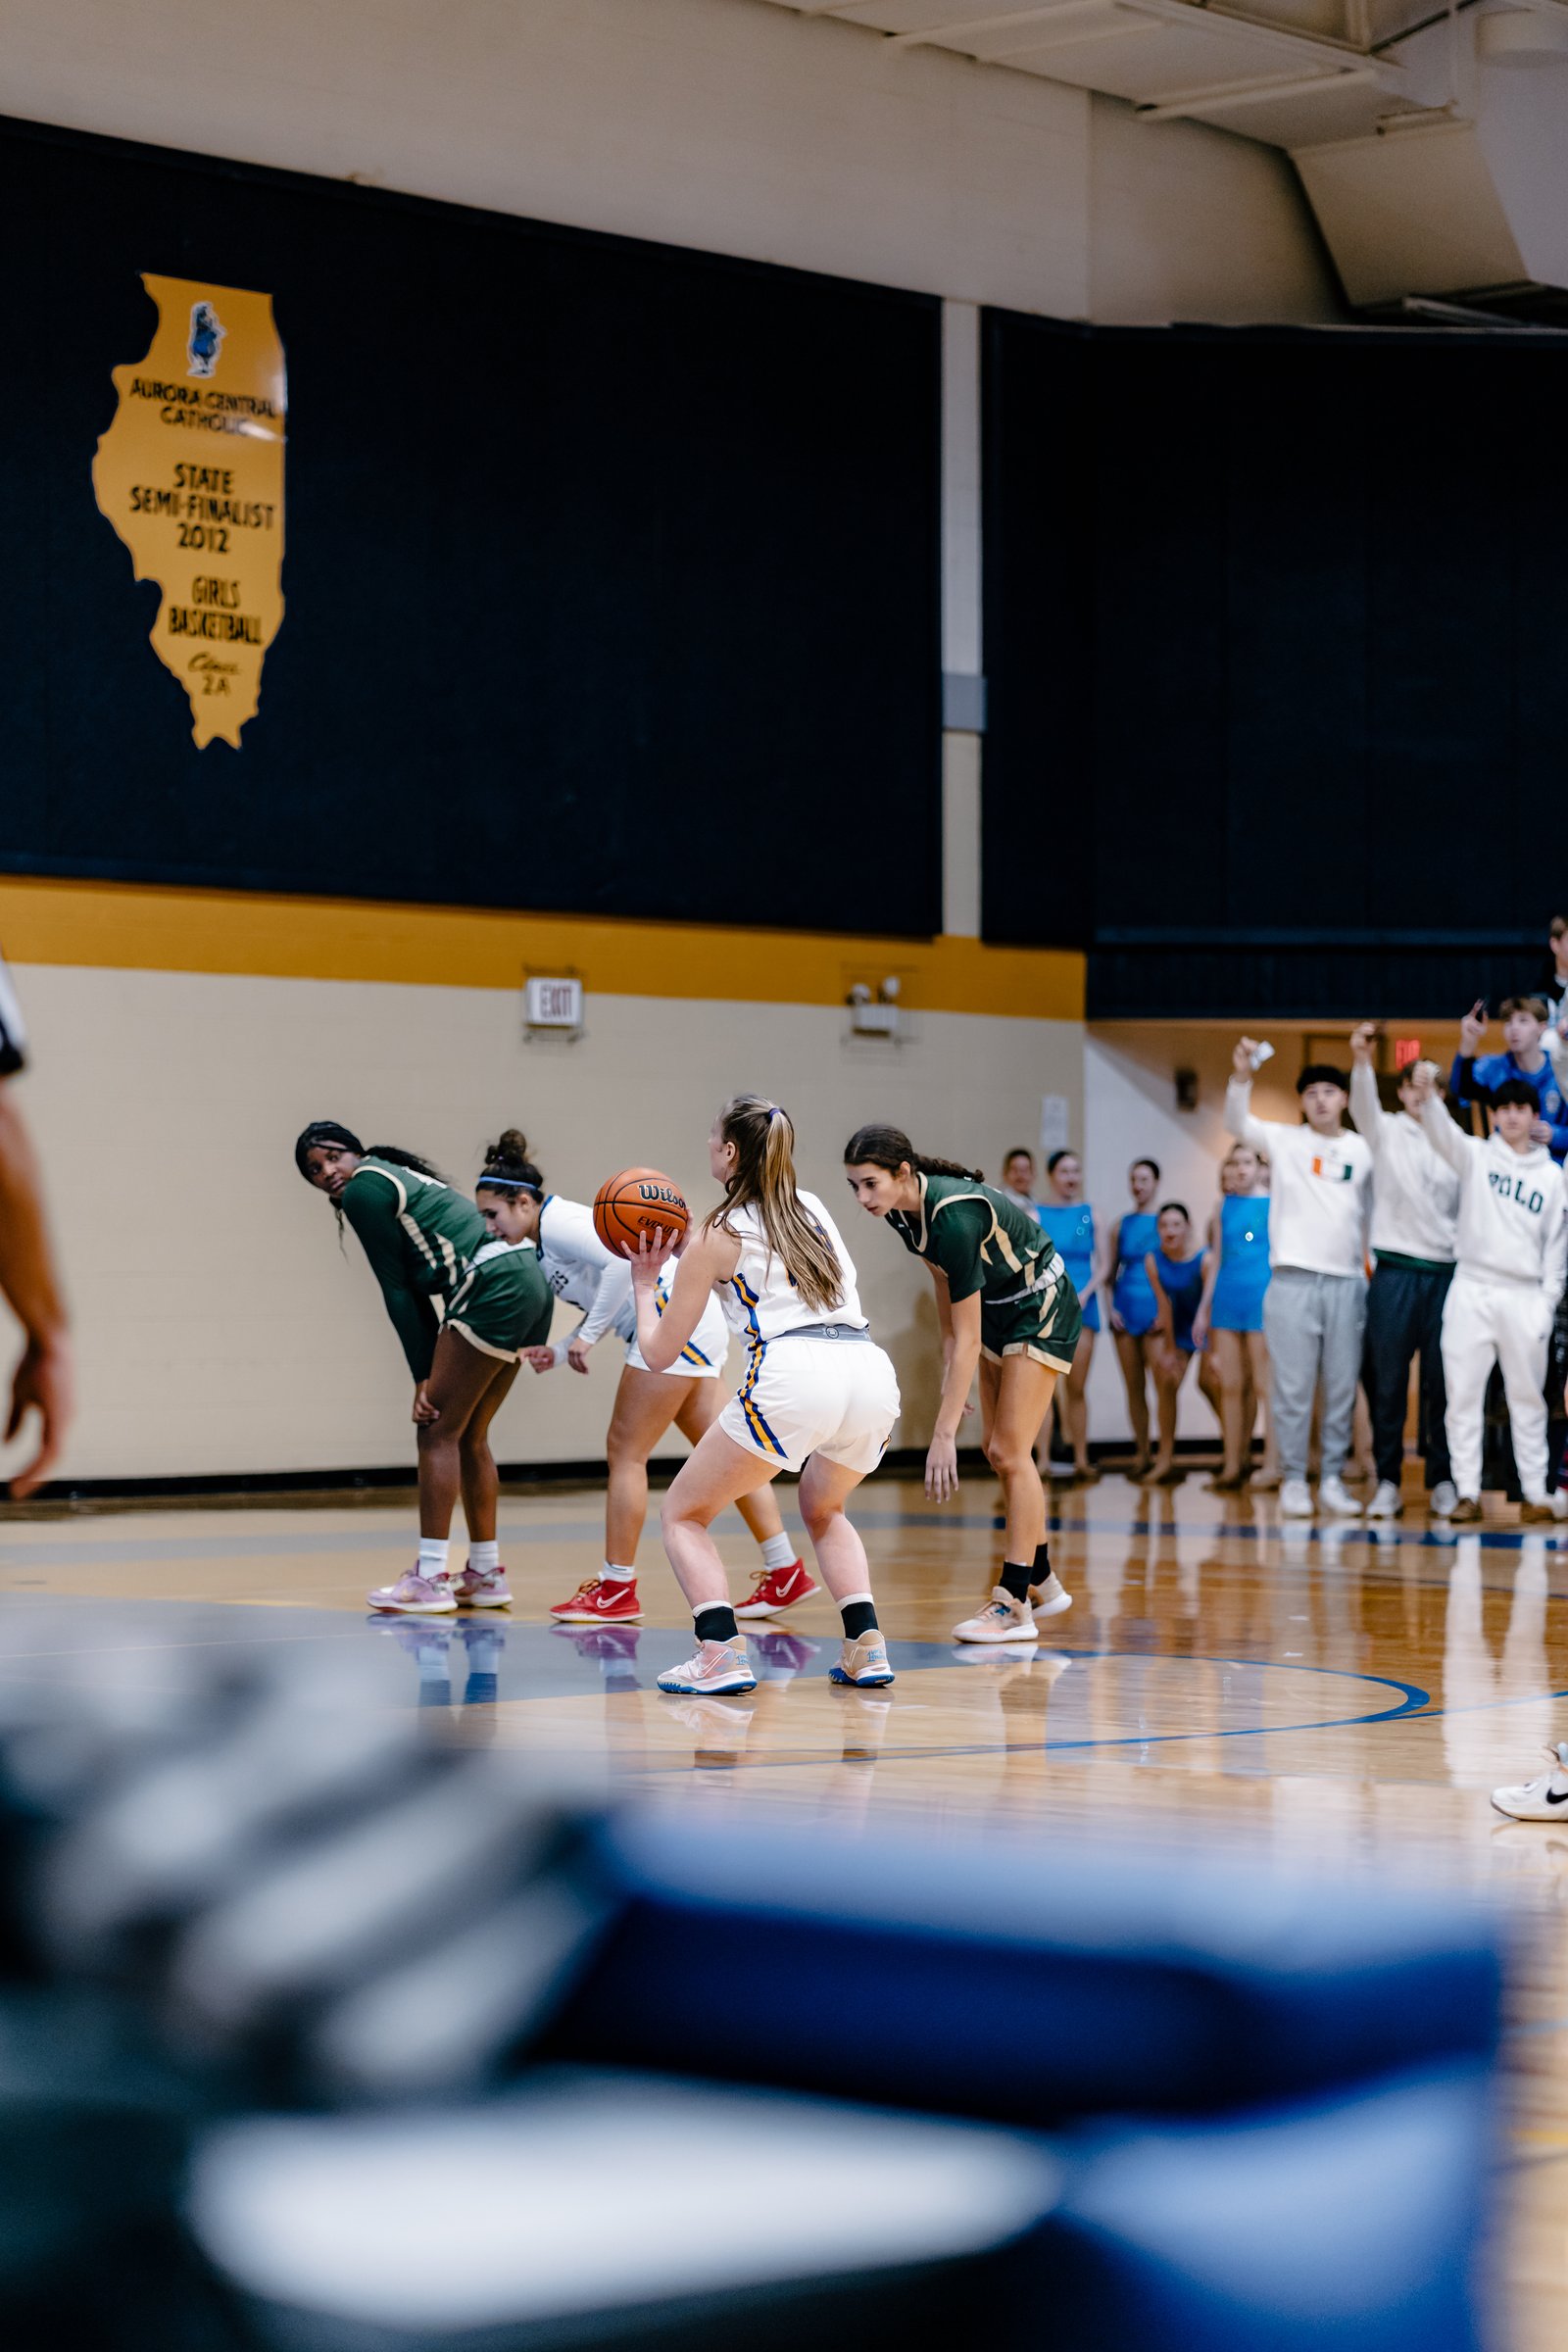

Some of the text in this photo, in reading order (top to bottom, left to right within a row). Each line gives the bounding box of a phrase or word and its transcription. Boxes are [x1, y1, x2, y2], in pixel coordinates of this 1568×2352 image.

[130, 378, 276, 418] AURORA CENTRAL
[174, 463, 234, 495] STATE
[130, 487, 274, 530] SEMI-FINALIST
[177, 523, 229, 553] 2012
[192, 576, 241, 609] GIRLS
[169, 608, 262, 646] BASKETBALL
[540, 985, 572, 1016] EXIT
[1489, 1172, 1544, 1214] POLO
